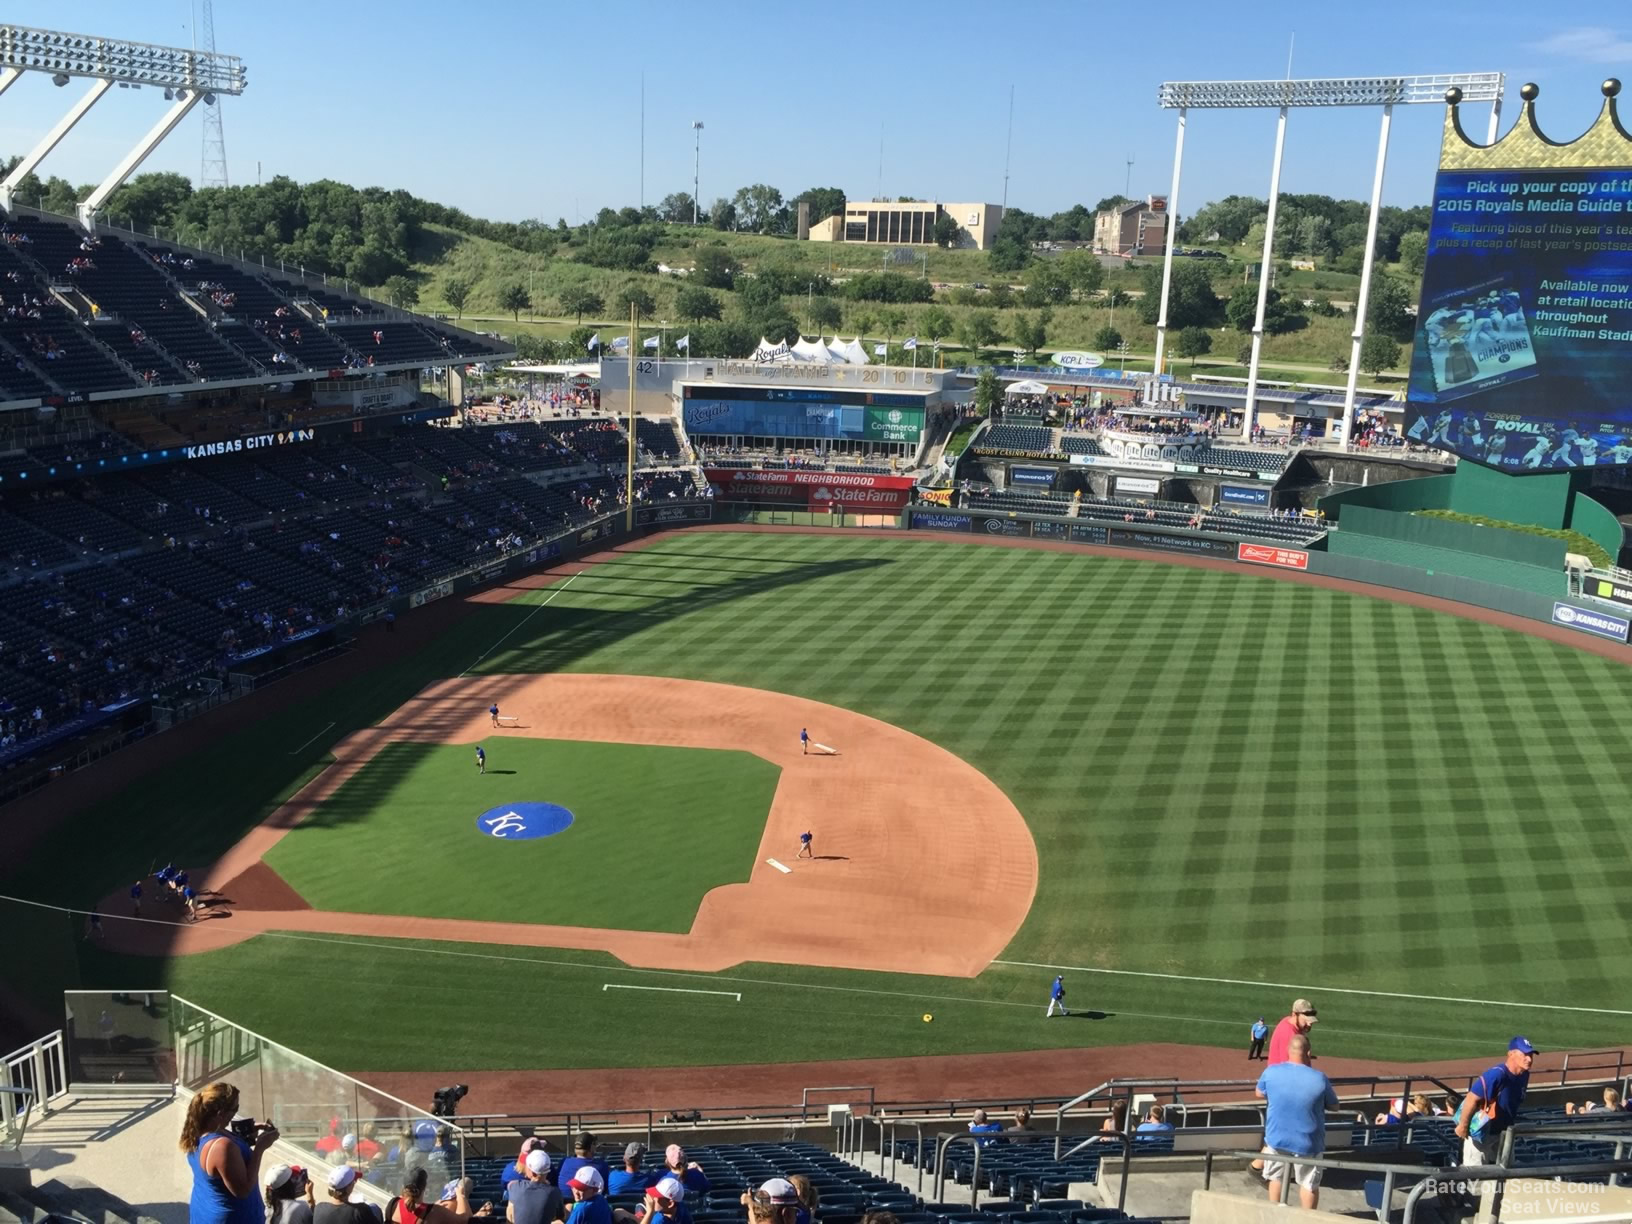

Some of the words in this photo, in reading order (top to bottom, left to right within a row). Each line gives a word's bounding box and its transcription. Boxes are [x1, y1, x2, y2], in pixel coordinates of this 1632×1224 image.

[1467, 181, 1497, 193] Pick
[1501, 183, 1519, 195] up
[1522, 183, 1557, 195] your
[1560, 182, 1597, 194] copy
[1601, 180, 1617, 192] of
[1438, 200, 1472, 212] 2015
[1475, 199, 1524, 214] Royals
[1527, 199, 1573, 212] Media
[1577, 199, 1622, 212] Guide
[1452, 222, 1504, 234] Featuring
[1507, 223, 1532, 233] bios
[1535, 223, 1547, 234] of
[1550, 224, 1572, 234] this
[1575, 224, 1613, 235] year's
[1436, 239, 1459, 249] plus
[1471, 241, 1503, 250] recap
[1506, 239, 1518, 248] of
[1520, 239, 1541, 248] last
[1545, 240, 1581, 251] year's
[1540, 280, 1598, 291] Available
[1601, 284, 1629, 293] now
[1538, 296, 1551, 305] at
[1554, 296, 1588, 307] retail
[1536, 310, 1608, 324] throughout
[1533, 325, 1595, 338] Kauffman
[755, 343, 791, 364] Royals
[1478, 339, 1528, 362] CHAMPIONS
[636, 362, 652, 373] 42
[717, 362, 761, 377] HALL
[782, 365, 829, 379] FAME
[863, 370, 879, 383] 20
[893, 371, 906, 384] 10
[925, 372, 933, 385] 5
[688, 402, 730, 424] Royals
[1485, 412, 1521, 420] FOREVER
[872, 423, 918, 432] Commerce
[1494, 420, 1540, 433] ROYAL
[884, 431, 906, 440] Bank
[188, 440, 242, 459] KANSAS
[246, 434, 274, 449] CITY
[1025, 451, 1047, 459] HOTEL
[1204, 467, 1222, 475] Quality
[1223, 469, 1250, 477] Healthcare
[794, 474, 875, 486] NEIGHBORHOOD
[833, 488, 865, 501] State
[867, 489, 898, 502] Farm
[920, 491, 950, 501] SONIC
[913, 513, 940, 521] FAMILY
[941, 515, 971, 523] FUNDAY
[927, 520, 958, 528] SUNDAY
[1134, 534, 1152, 542] Now,
[1162, 537, 1191, 546] Network
[1576, 613, 1608, 630] KANSAS
[1607, 622, 1626, 633] CITY
[485, 811, 526, 837] KC
